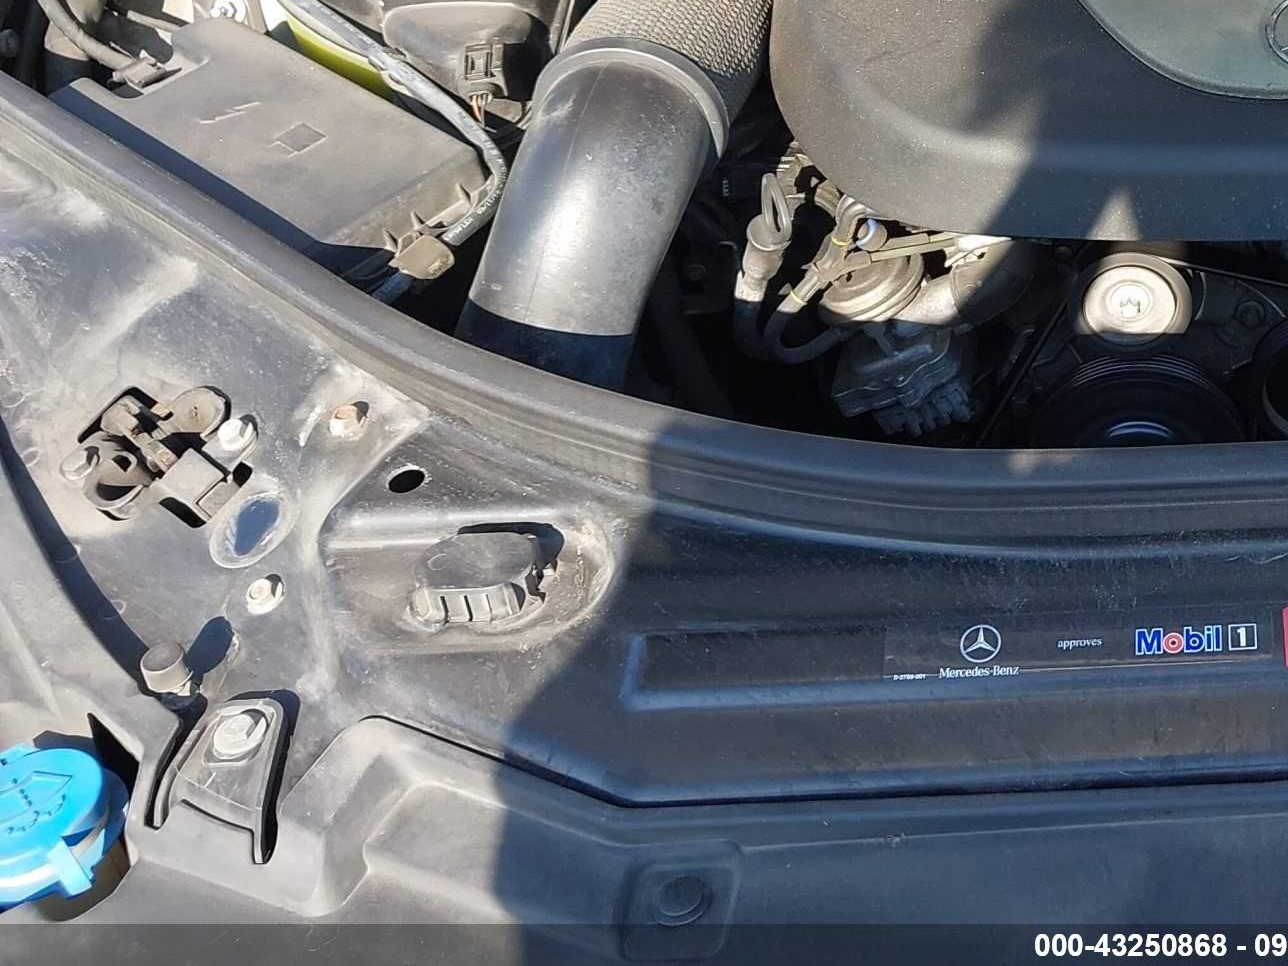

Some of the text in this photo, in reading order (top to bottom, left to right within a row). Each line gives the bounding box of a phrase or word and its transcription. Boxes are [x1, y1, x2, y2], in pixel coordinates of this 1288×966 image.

[1057, 637, 1102, 649] approves
[1135, 625, 1222, 656] Mobil
[939, 666, 1019, 679] Mercedes-Benz
